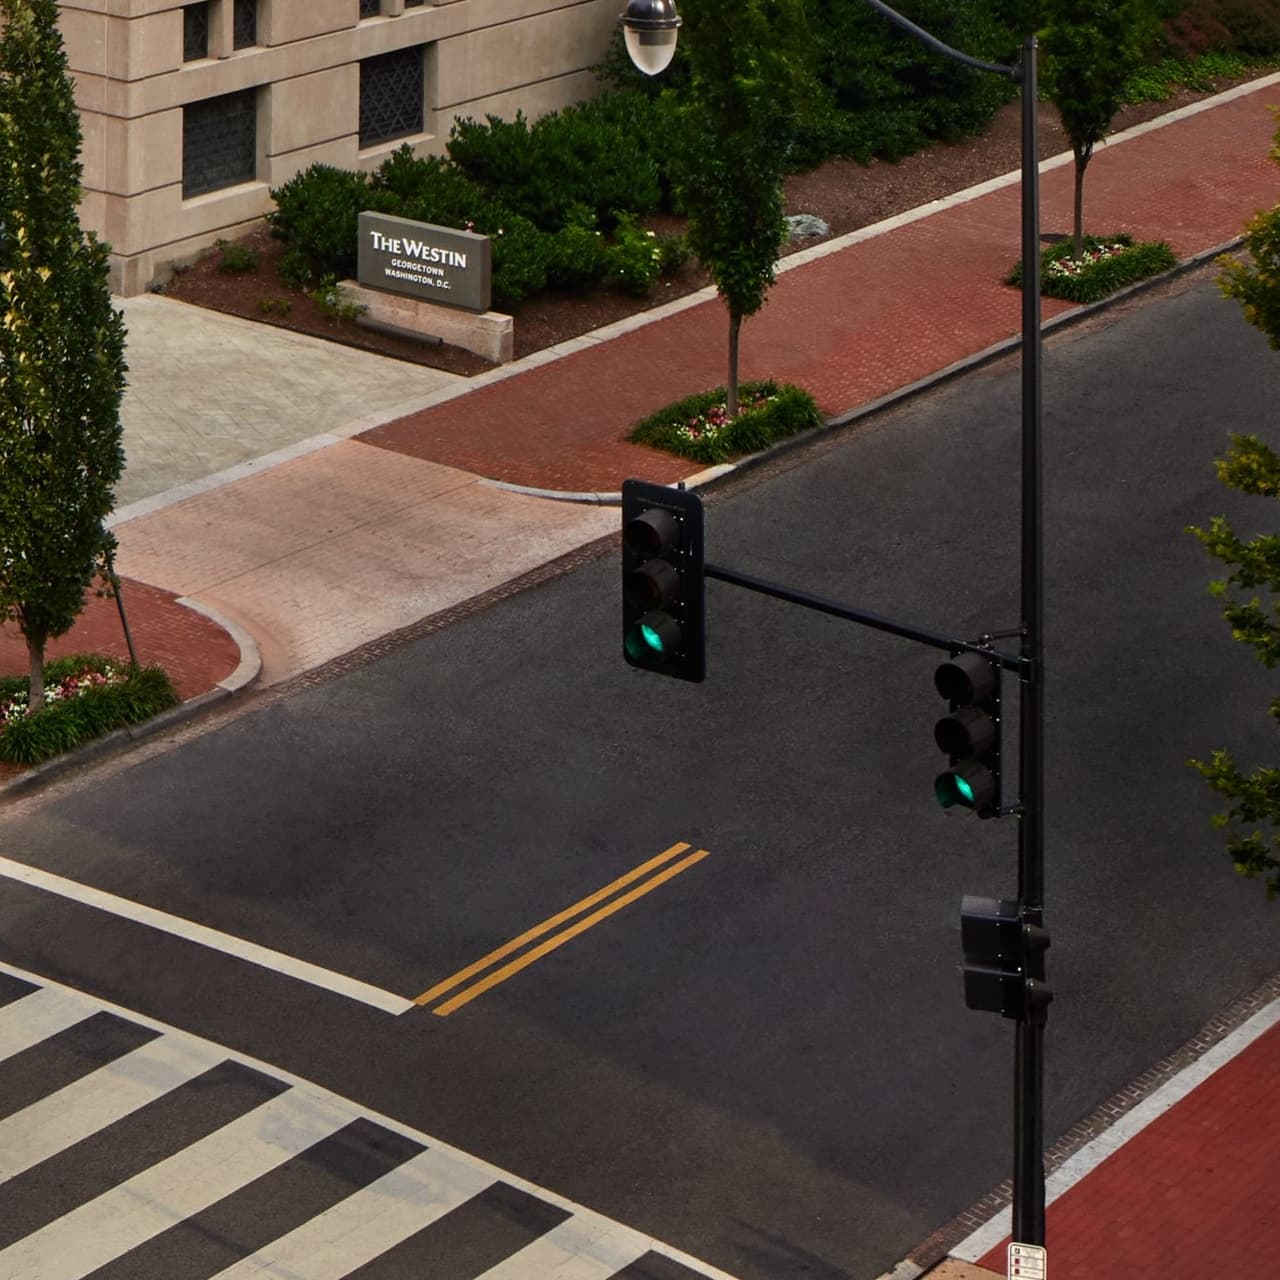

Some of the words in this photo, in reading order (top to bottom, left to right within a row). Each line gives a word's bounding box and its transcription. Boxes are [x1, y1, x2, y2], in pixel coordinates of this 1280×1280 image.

[369, 231, 401, 254] THE
[402, 238, 467, 268] WESTIN
[391, 258, 444, 277] GEORGETOWN
[384, 268, 435, 287] WASHINGTON,
[436, 280, 451, 290] D.C.
